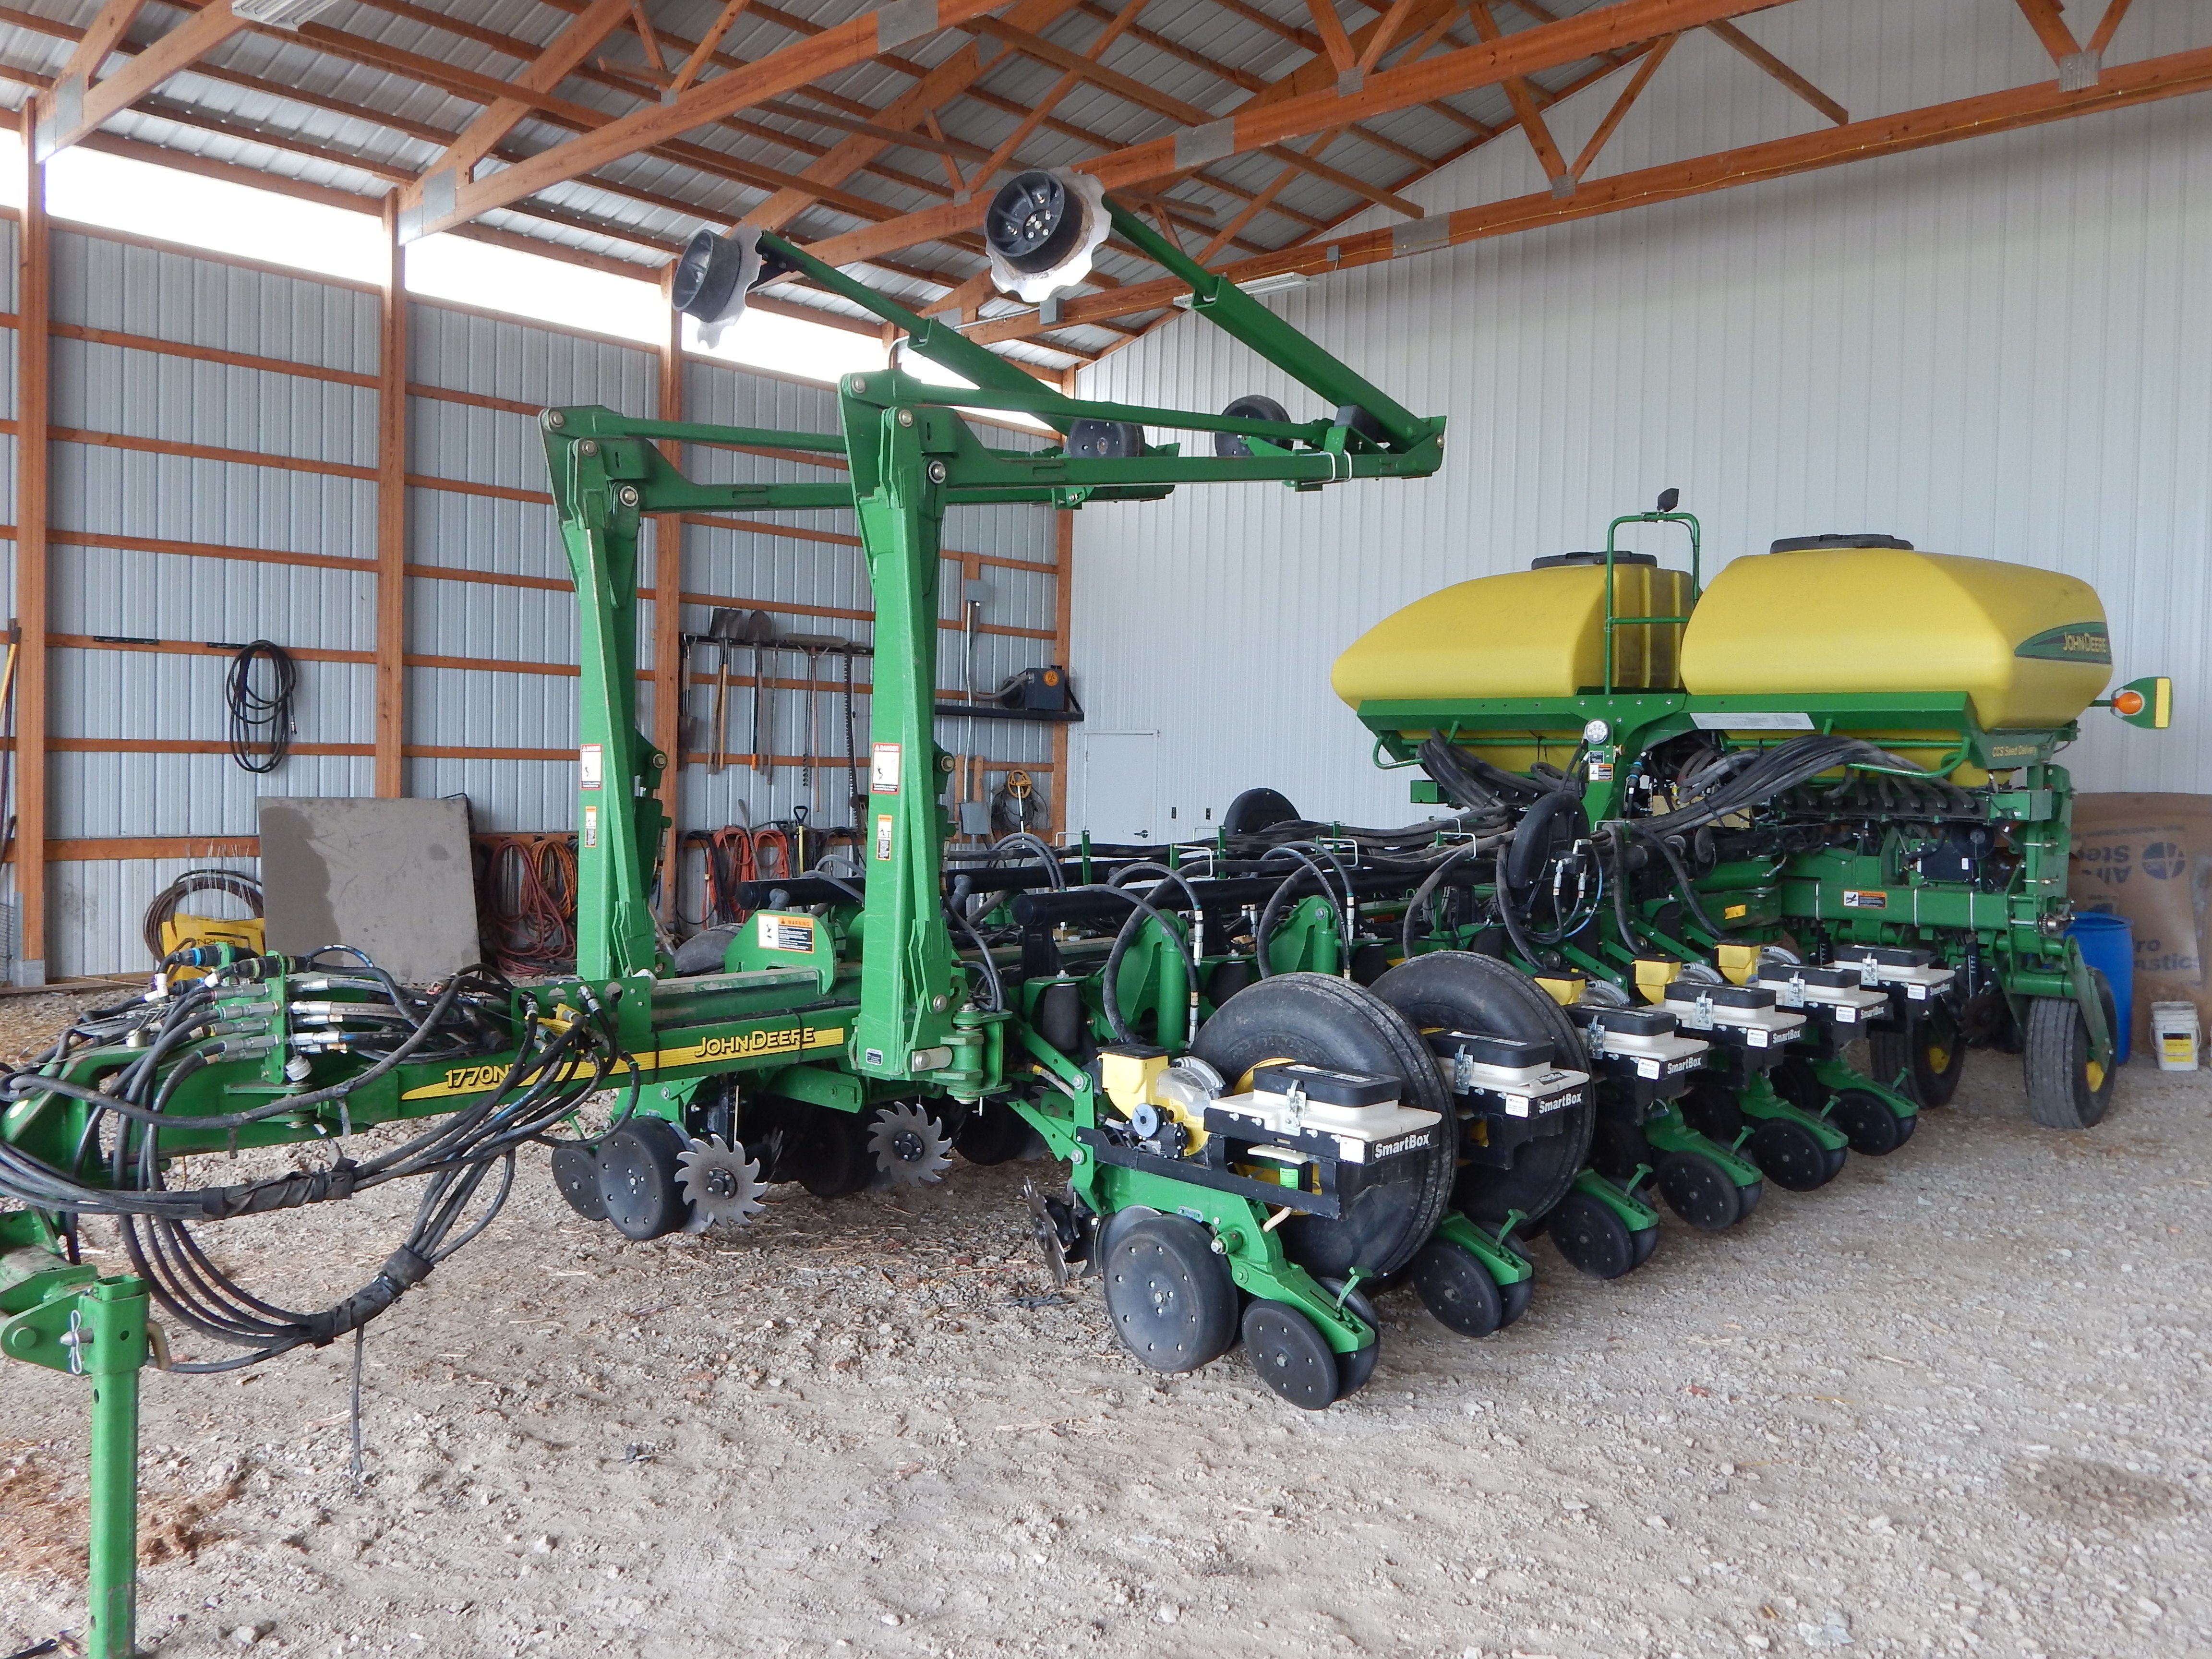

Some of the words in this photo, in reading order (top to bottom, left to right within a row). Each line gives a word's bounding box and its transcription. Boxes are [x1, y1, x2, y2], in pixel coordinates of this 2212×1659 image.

[2063, 632, 2084, 651] JOHN
[695, 1035, 749, 1058] JOHN
[751, 1027, 816, 1050] DEERE
[1772, 1029, 1801, 1044] SmartBox
[1667, 1056, 1702, 1075] SmartBox
[1539, 1093, 1582, 1114] SmartBox
[1375, 1133, 1430, 1158] SmartBox
